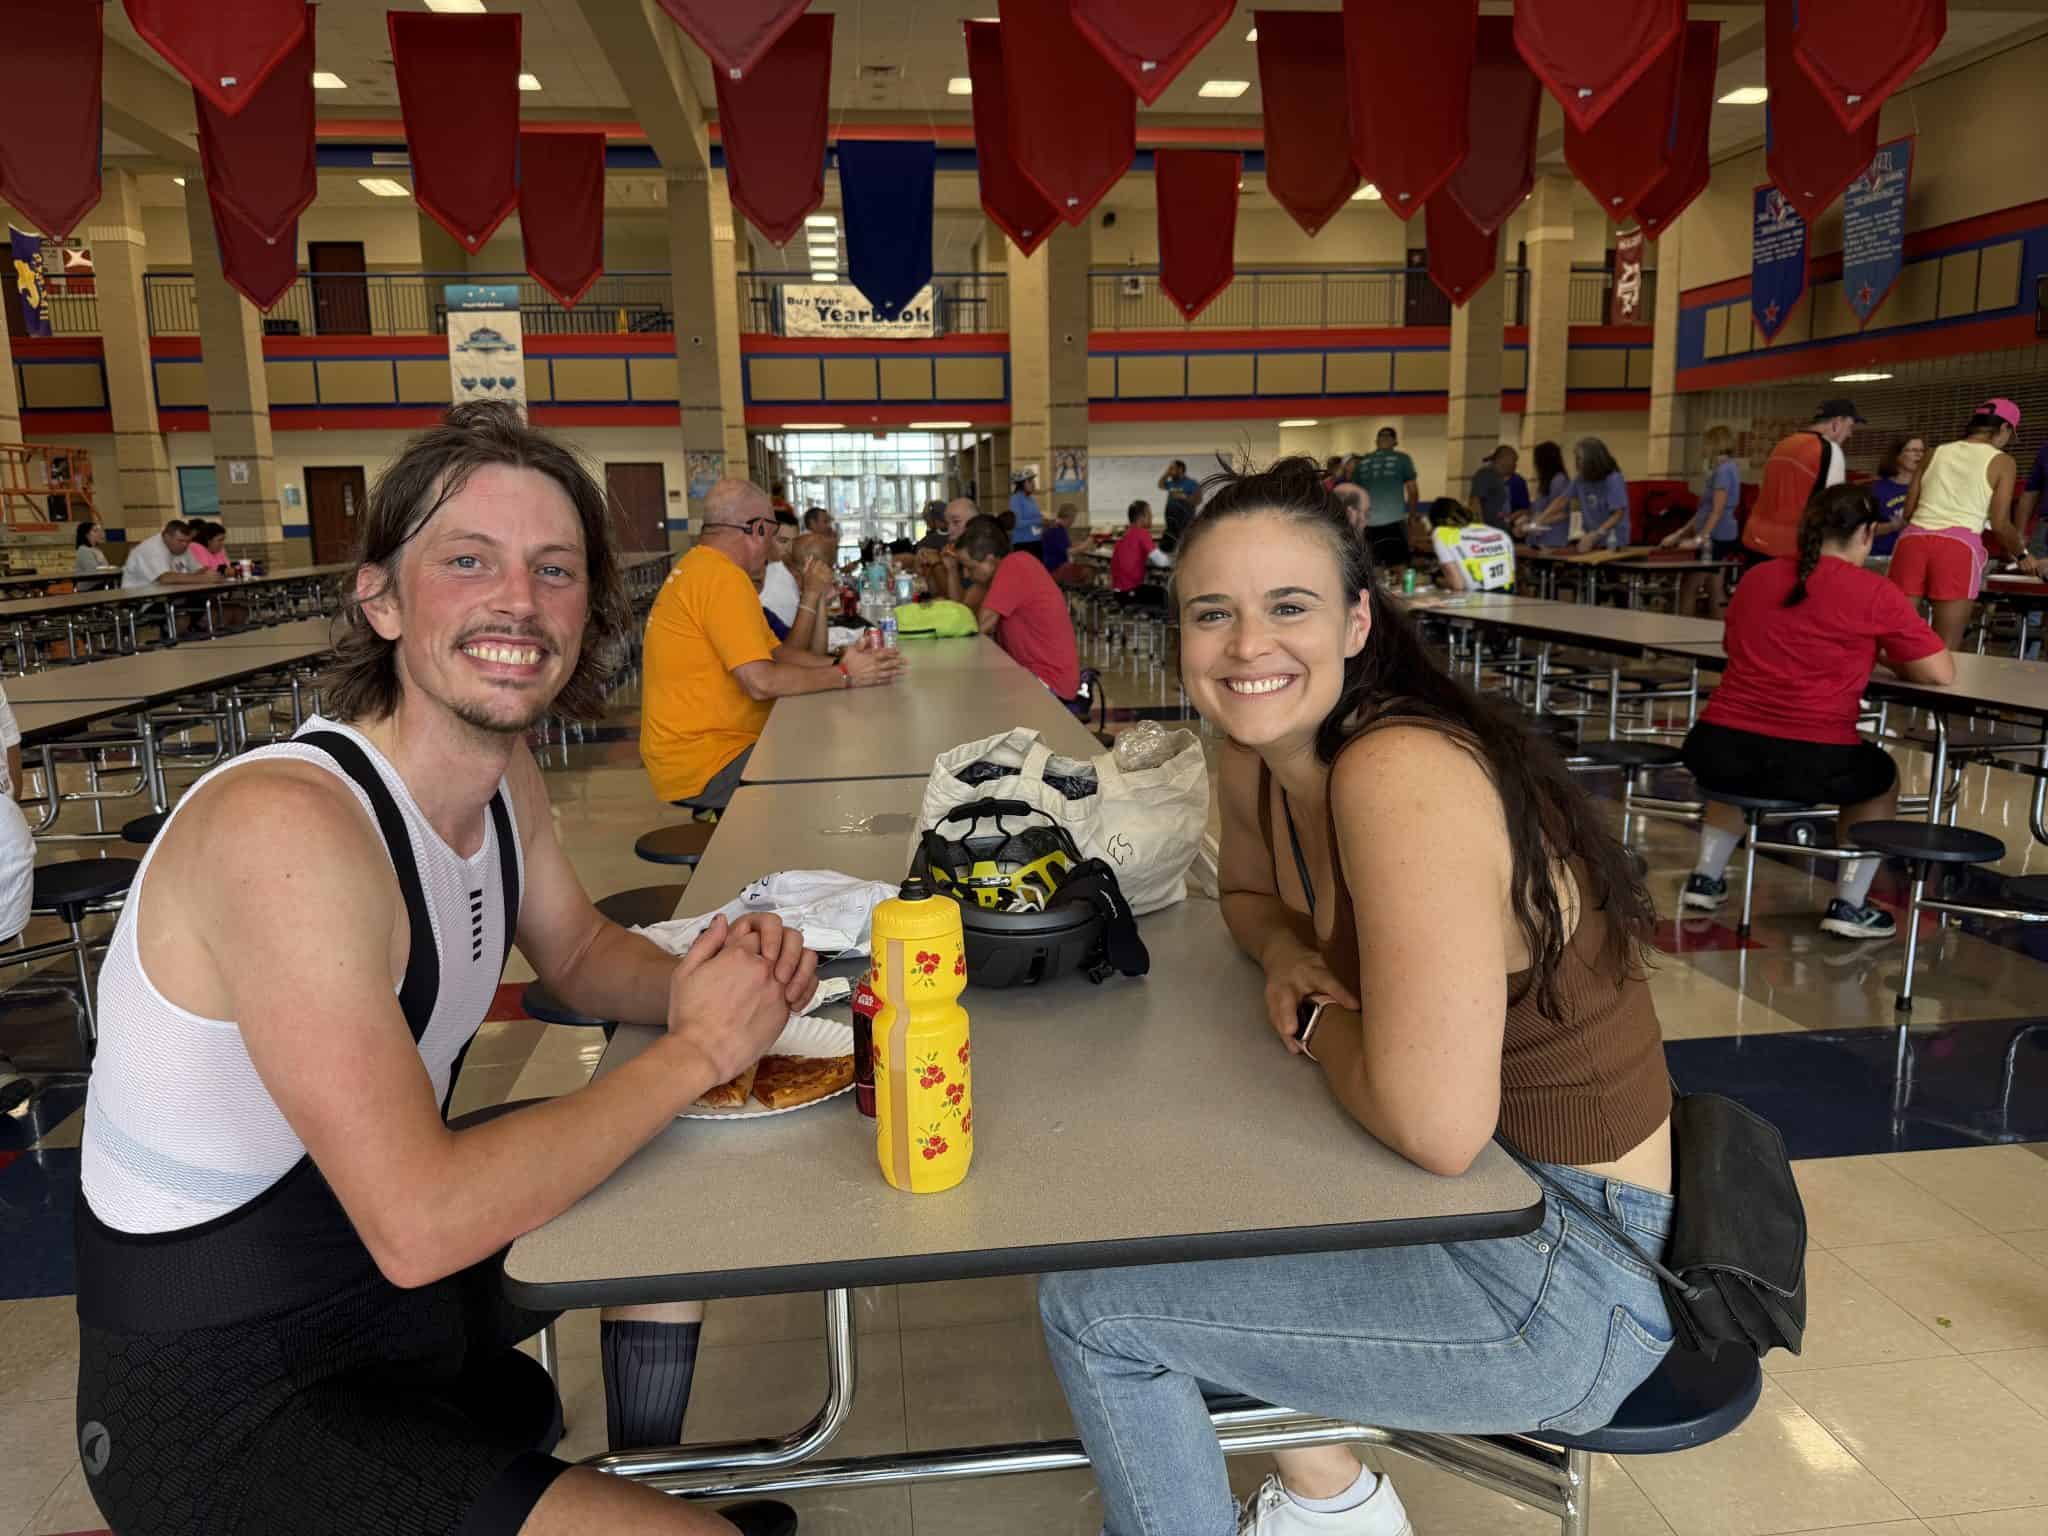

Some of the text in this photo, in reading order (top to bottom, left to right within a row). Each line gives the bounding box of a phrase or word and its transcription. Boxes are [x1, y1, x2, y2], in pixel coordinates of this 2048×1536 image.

[786, 296, 841, 307] Buy Your
[816, 306, 931, 323] Yearbok
